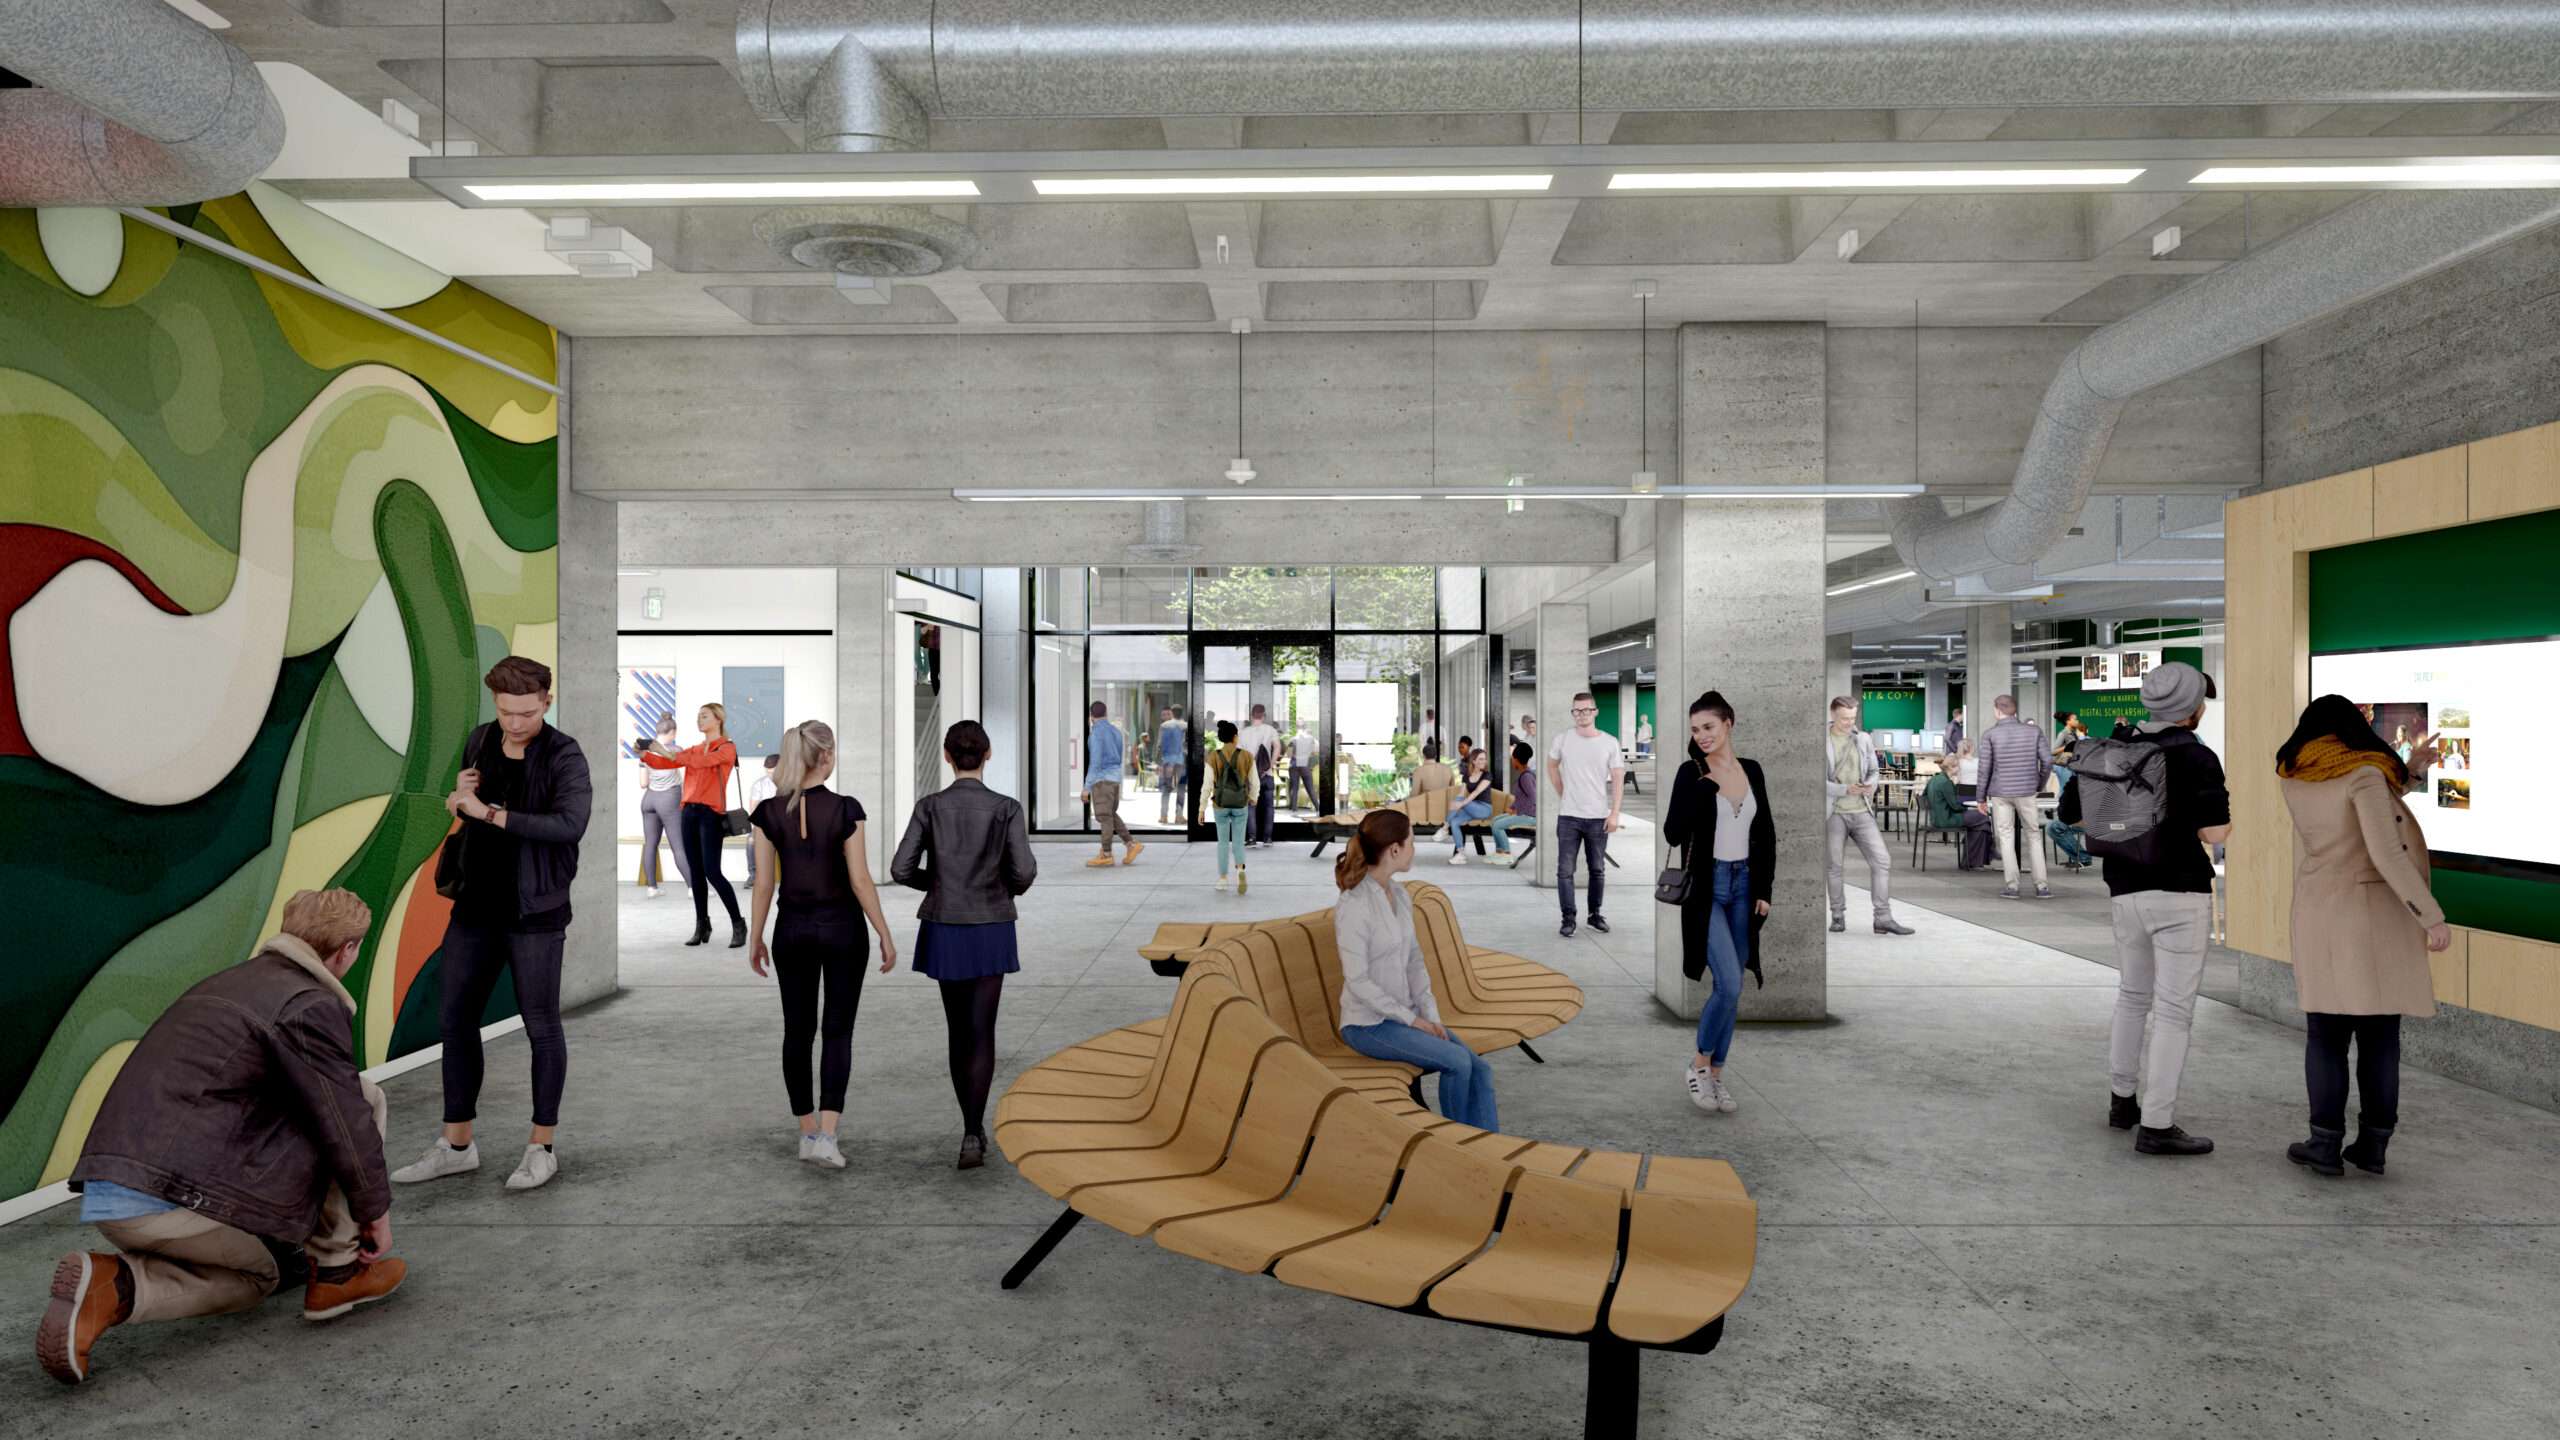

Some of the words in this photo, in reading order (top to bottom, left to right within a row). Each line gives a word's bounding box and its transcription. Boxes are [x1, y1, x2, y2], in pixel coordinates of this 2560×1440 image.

[1876, 691, 1884, 700] &
[1888, 691, 1914, 700] COPY
[2080, 708, 2102, 717] DIGITAL
